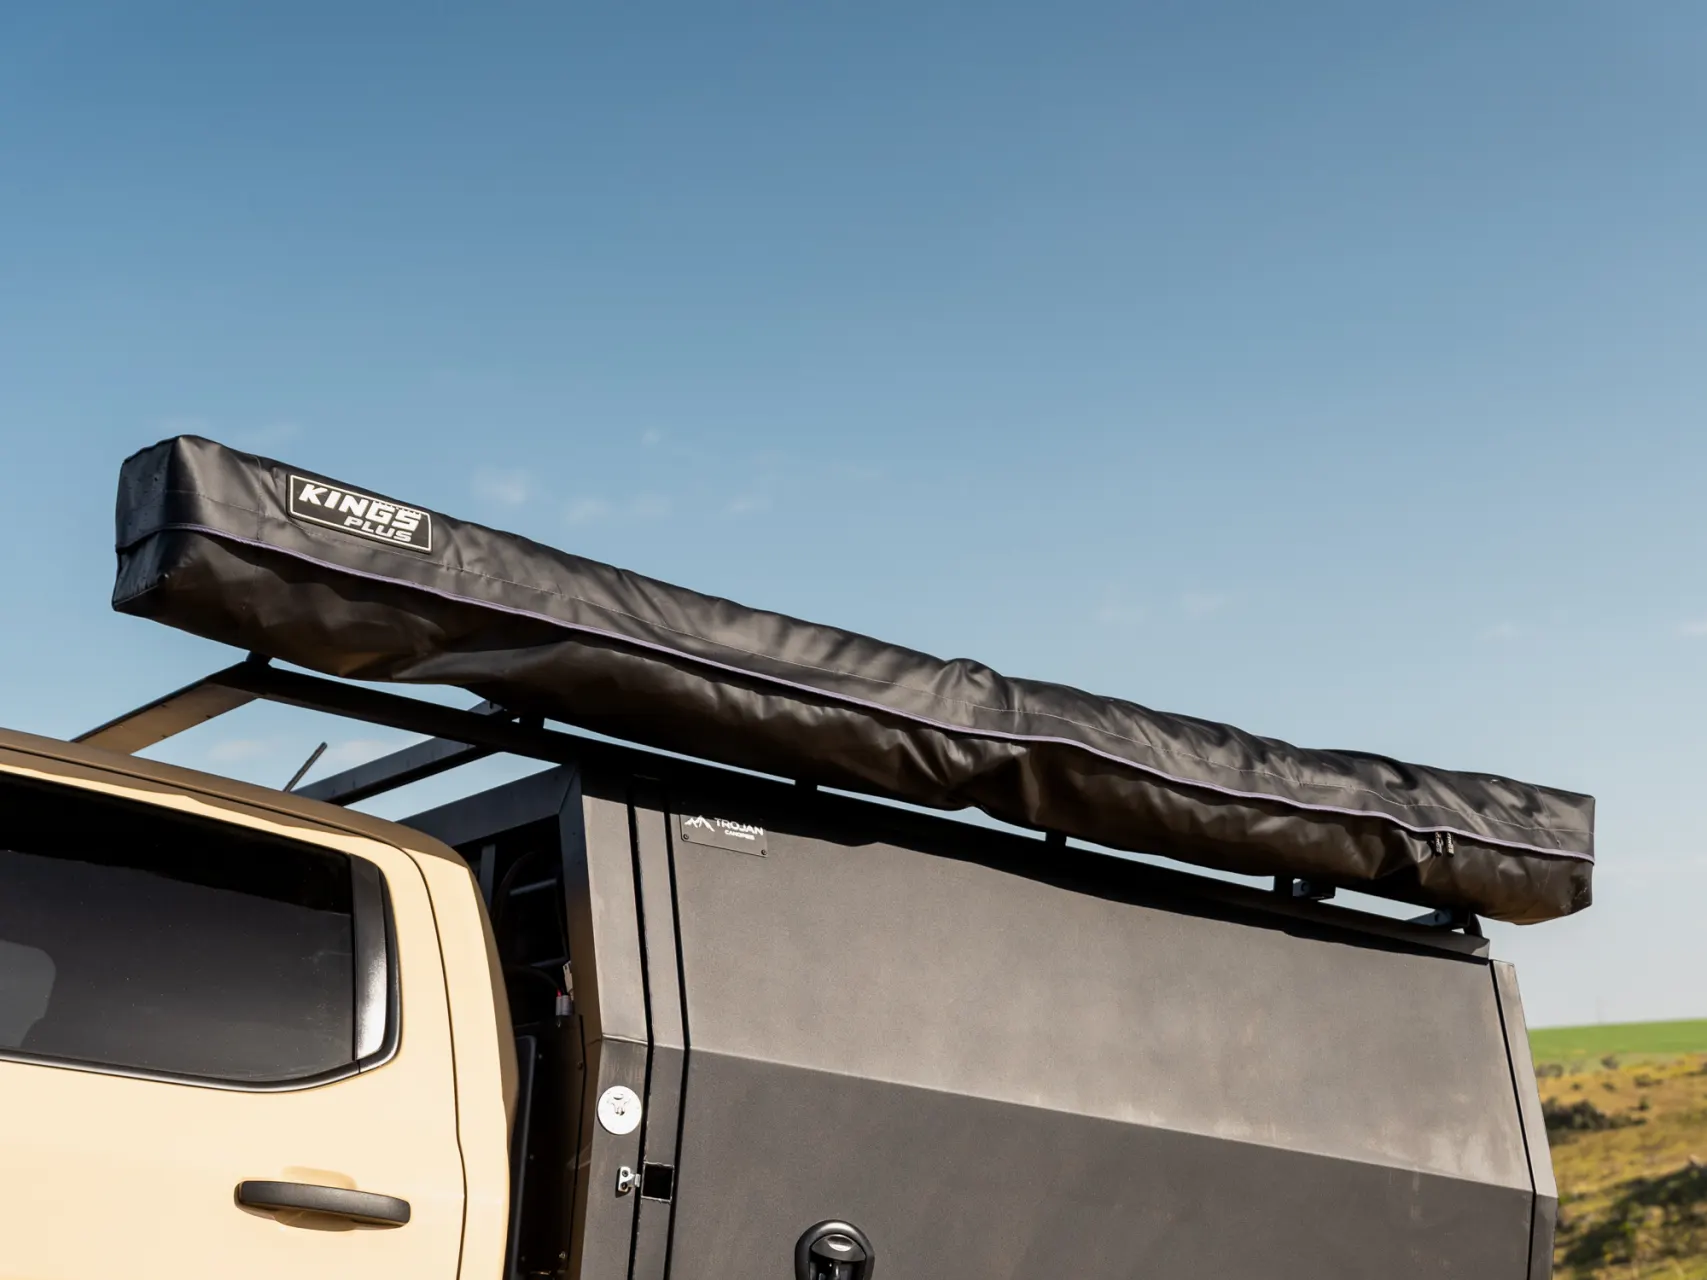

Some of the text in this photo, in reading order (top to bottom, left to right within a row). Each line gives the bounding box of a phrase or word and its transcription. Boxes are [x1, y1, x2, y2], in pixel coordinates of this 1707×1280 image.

[298, 483, 422, 532] KINGS
[343, 516, 413, 542] PLUS
[714, 817, 764, 836] TROJAN
